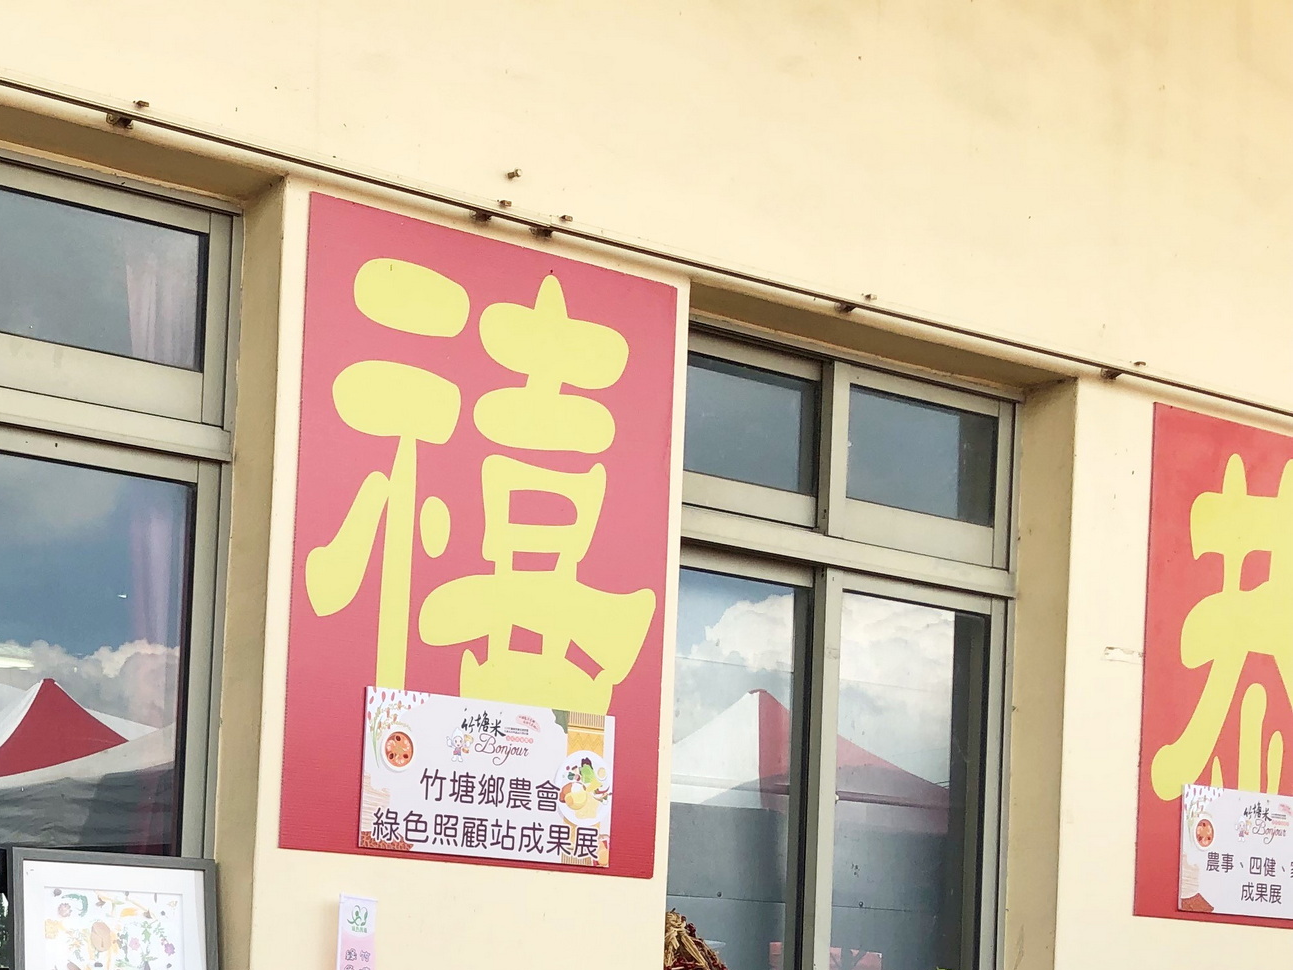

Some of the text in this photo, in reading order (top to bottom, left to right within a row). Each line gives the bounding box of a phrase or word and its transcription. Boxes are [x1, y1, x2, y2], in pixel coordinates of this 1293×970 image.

[305, 257, 657, 716] 禧
[474, 732, 529, 767] Bonjour
[419, 767, 561, 813] 竹塘鄉農會
[371, 807, 599, 860] 綠色照顧站成果展
[1206, 851, 1293, 878] 農事、四健、
[1240, 882, 1283, 905] 成果展
